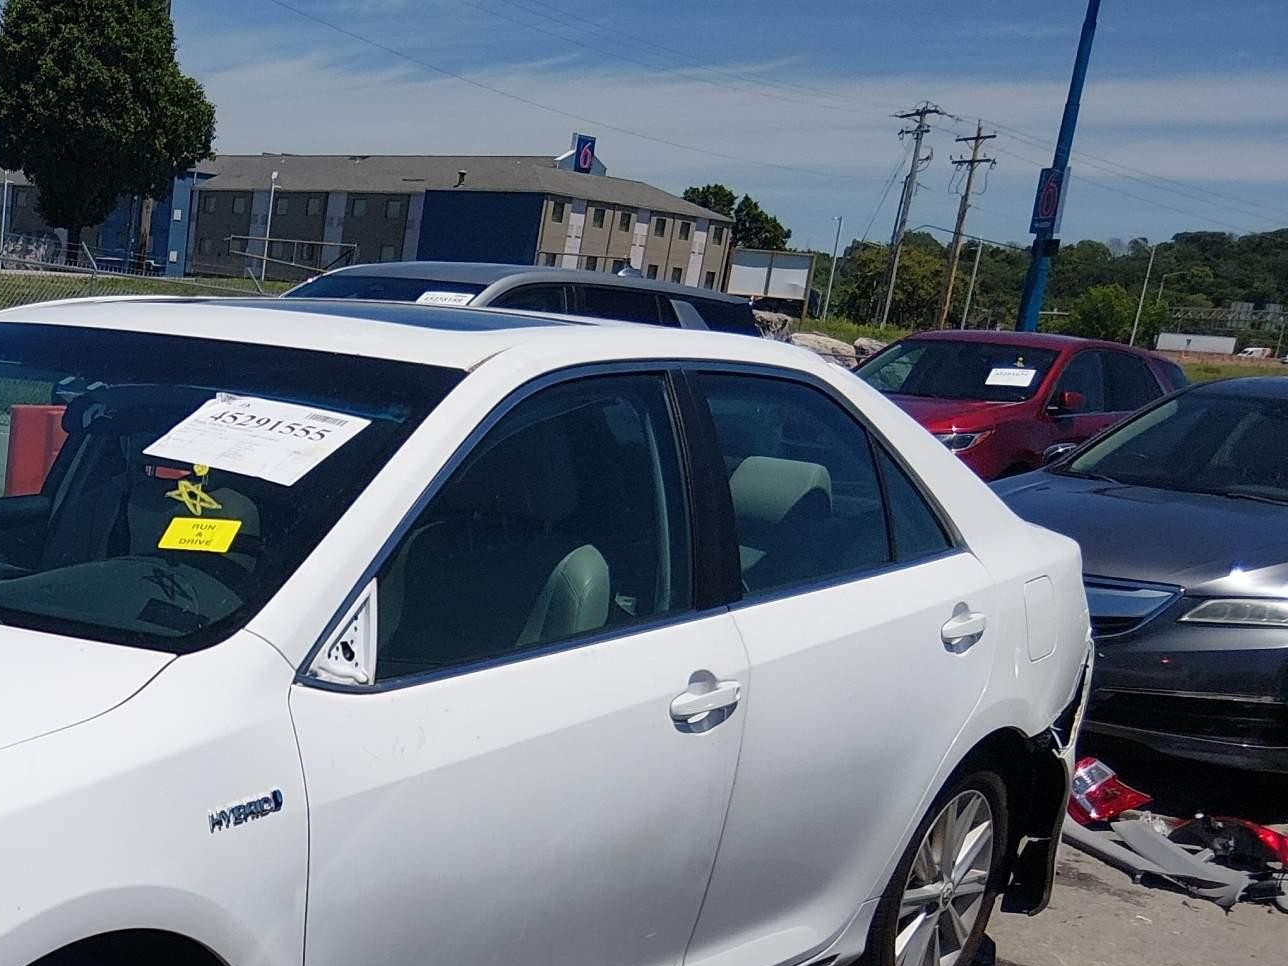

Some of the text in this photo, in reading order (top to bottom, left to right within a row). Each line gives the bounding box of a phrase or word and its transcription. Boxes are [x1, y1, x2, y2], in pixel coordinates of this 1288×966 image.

[579, 142, 592, 169] 6
[1039, 173, 1058, 218] 6
[210, 410, 332, 442] 45291555
[178, 537, 212, 546] DRIVE
[208, 795, 275, 834] HYBRID
